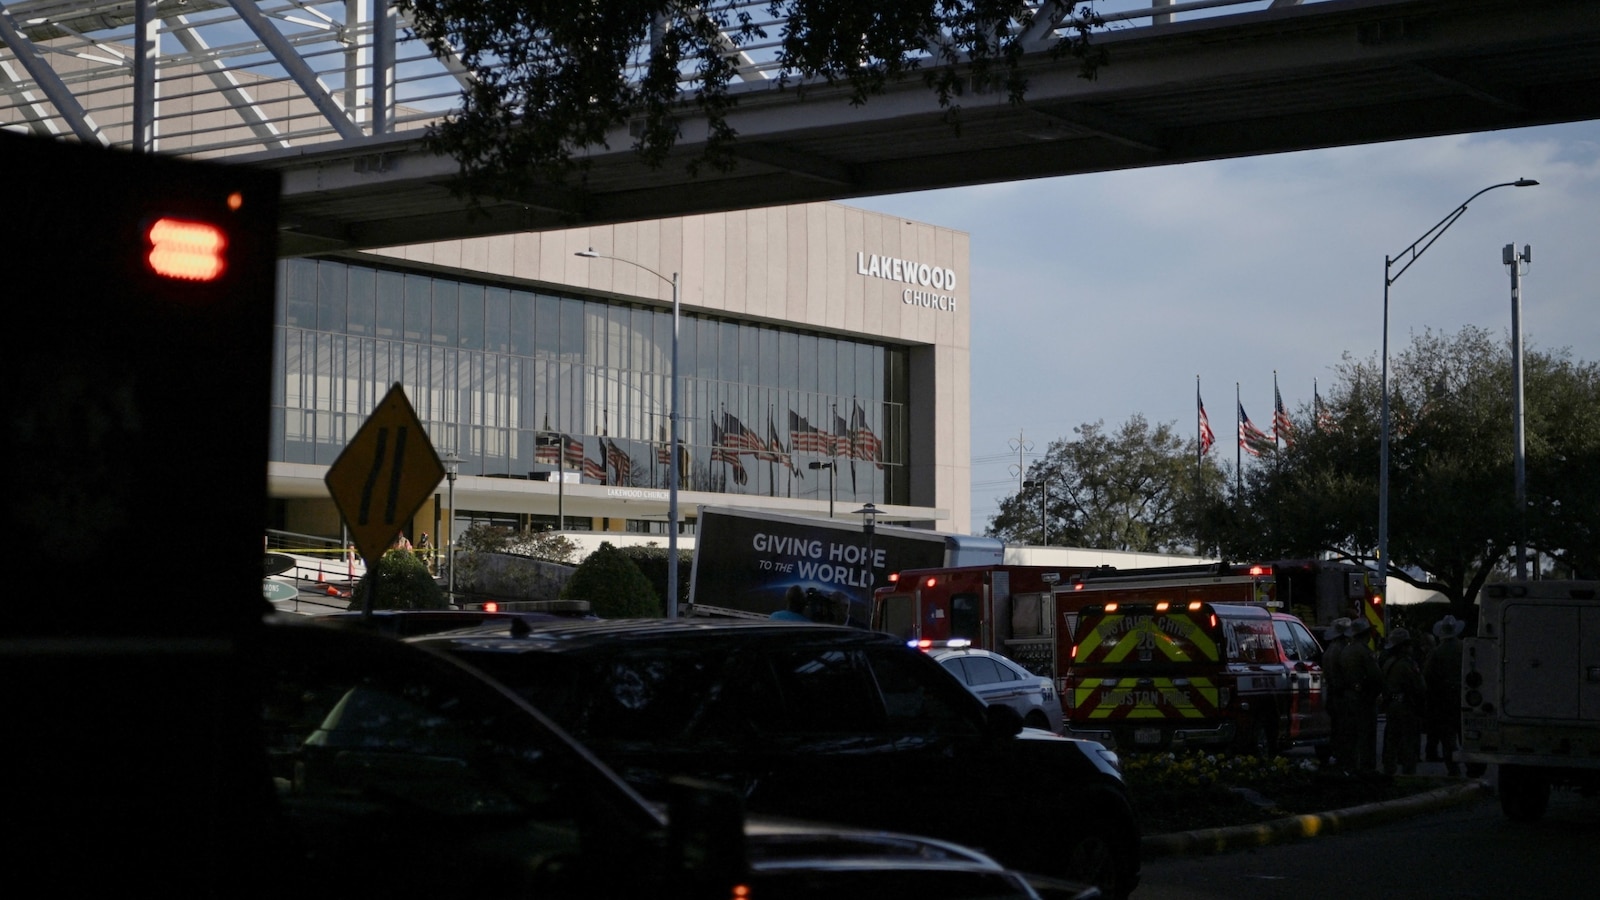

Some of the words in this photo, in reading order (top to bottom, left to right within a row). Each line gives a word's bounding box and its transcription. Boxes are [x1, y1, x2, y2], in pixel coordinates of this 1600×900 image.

[857, 252, 956, 291] LAKEWOOD
[902, 288, 956, 312] CHURCH
[607, 488, 643, 498] LAKEWOOD
[643, 491, 669, 499] CHURCH
[753, 533, 823, 559] GIVING
[829, 543, 887, 568] HOPE
[759, 560, 772, 571] TO
[774, 562, 794, 573] THE
[798, 560, 875, 588] WORLD
[1097, 615, 1154, 639] DISTRICT
[1136, 631, 1156, 650] 28
[1101, 690, 1158, 706] HOUSTON
[1162, 690, 1191, 706] FIRE
